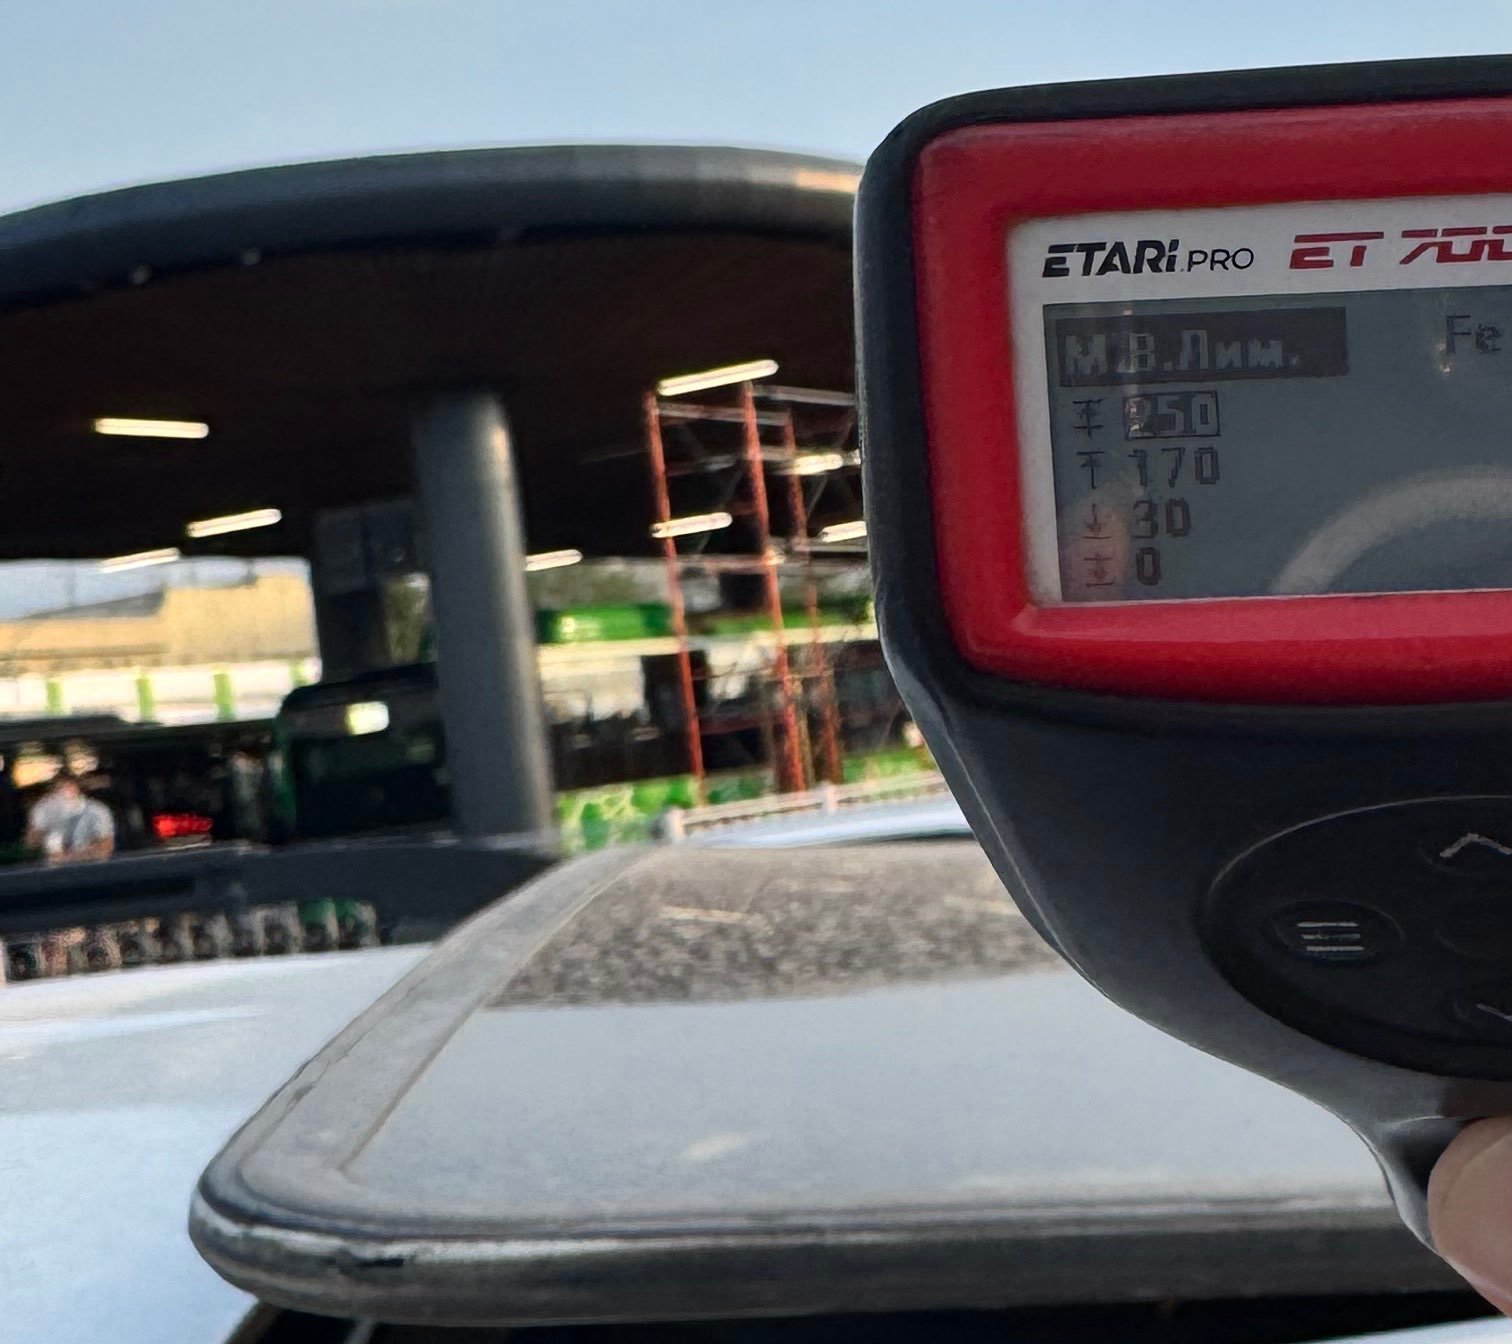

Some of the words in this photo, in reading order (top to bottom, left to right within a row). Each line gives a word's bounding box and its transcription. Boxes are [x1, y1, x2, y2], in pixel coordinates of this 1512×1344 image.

[1289, 231, 1385, 269] ET
[1445, 314, 1504, 354] Fe
[1125, 394, 1219, 437] 250
[1129, 447, 1220, 488] 170
[1131, 497, 1192, 539] 30
[1136, 546, 1161, 586] 0
